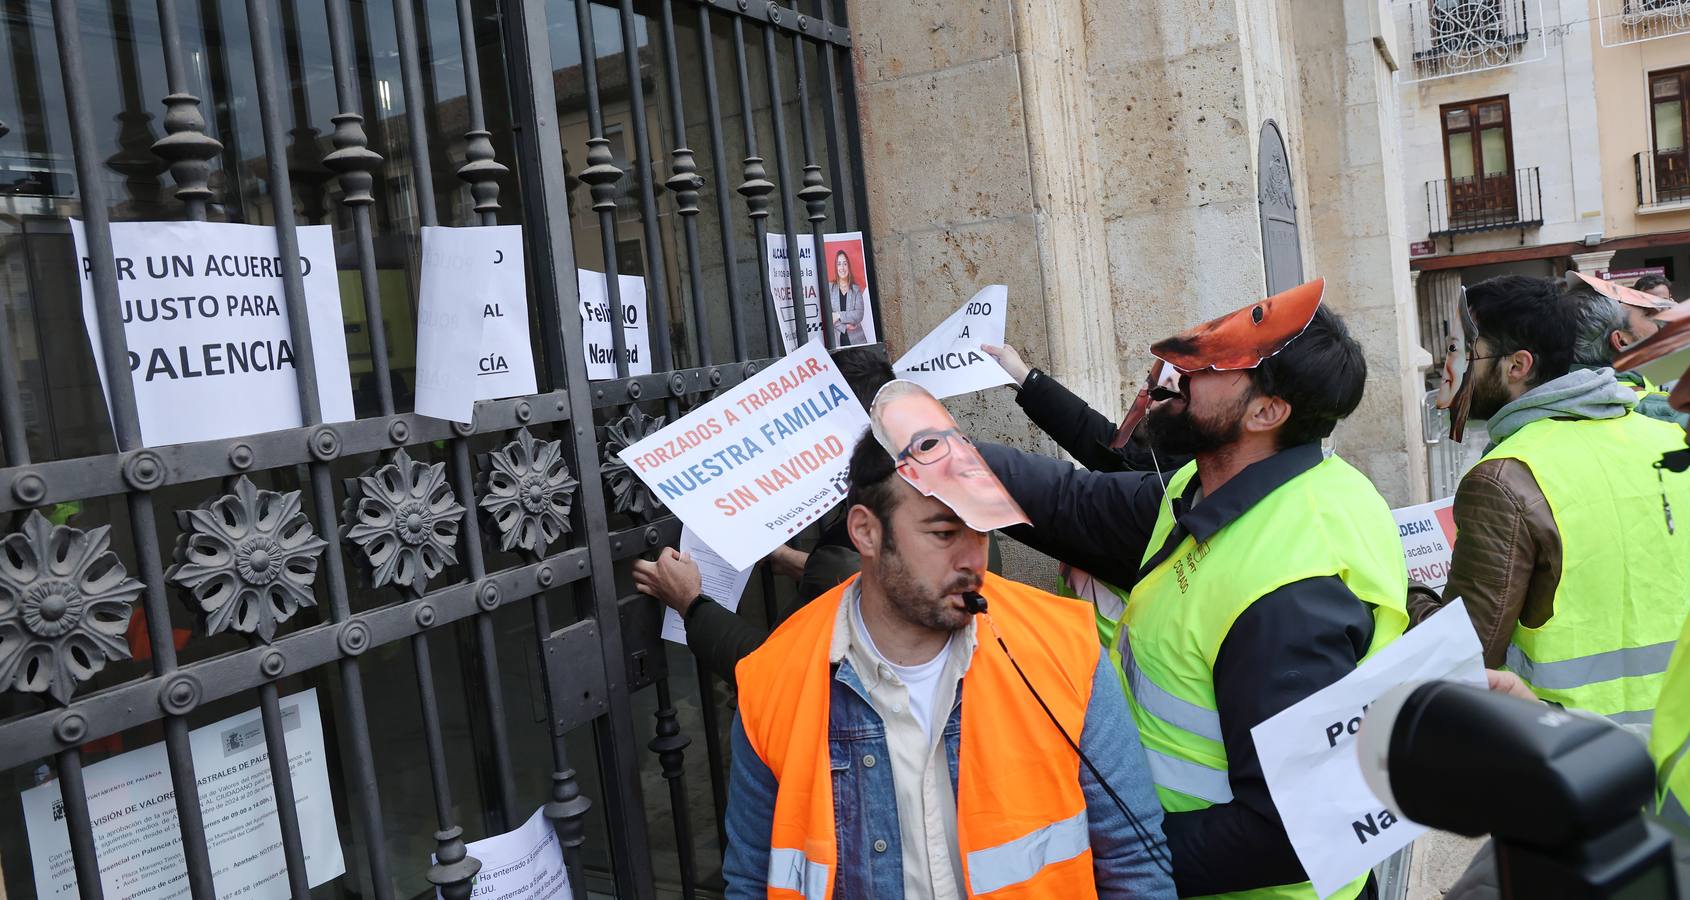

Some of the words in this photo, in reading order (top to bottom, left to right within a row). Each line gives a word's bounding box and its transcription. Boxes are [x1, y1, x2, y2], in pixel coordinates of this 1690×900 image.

[83, 256, 136, 280] PR
[146, 255, 194, 279] UN
[806, 267, 813, 277] la
[123, 295, 219, 324] JUSTO
[227, 295, 280, 317] PARA
[483, 304, 504, 318] AL
[479, 353, 508, 372] CÍA
[589, 344, 638, 364] Naviad
[633, 417, 723, 473] FORZADOS
[723, 408, 740, 427] A
[736, 356, 829, 416] TRABAJAR,
[657, 435, 764, 501] NUESTRA
[760, 383, 849, 446] FAMILIA
[714, 485, 760, 517] SIN
[754, 434, 844, 496] NAVIDAD
[801, 486, 831, 509] Local
[1407, 545, 1433, 558] acaba
[1433, 542, 1444, 551] la
[87, 783, 126, 800] YUNTAMIENTO
[135, 771, 162, 784] PALENCIA
[91, 810, 122, 828] EVISIÓN
[125, 804, 137, 815] DE
[139, 791, 176, 809] VALORE
[197, 766, 237, 786] ASTRALES
[238, 761, 249, 770] DE
[215, 783, 253, 801] CIUDADANO
[162, 807, 177, 816] nuev
[100, 856, 130, 873] resencial
[141, 841, 172, 857] Palencia
[480, 873, 491, 882] Ha
[493, 860, 527, 879] enterrado
